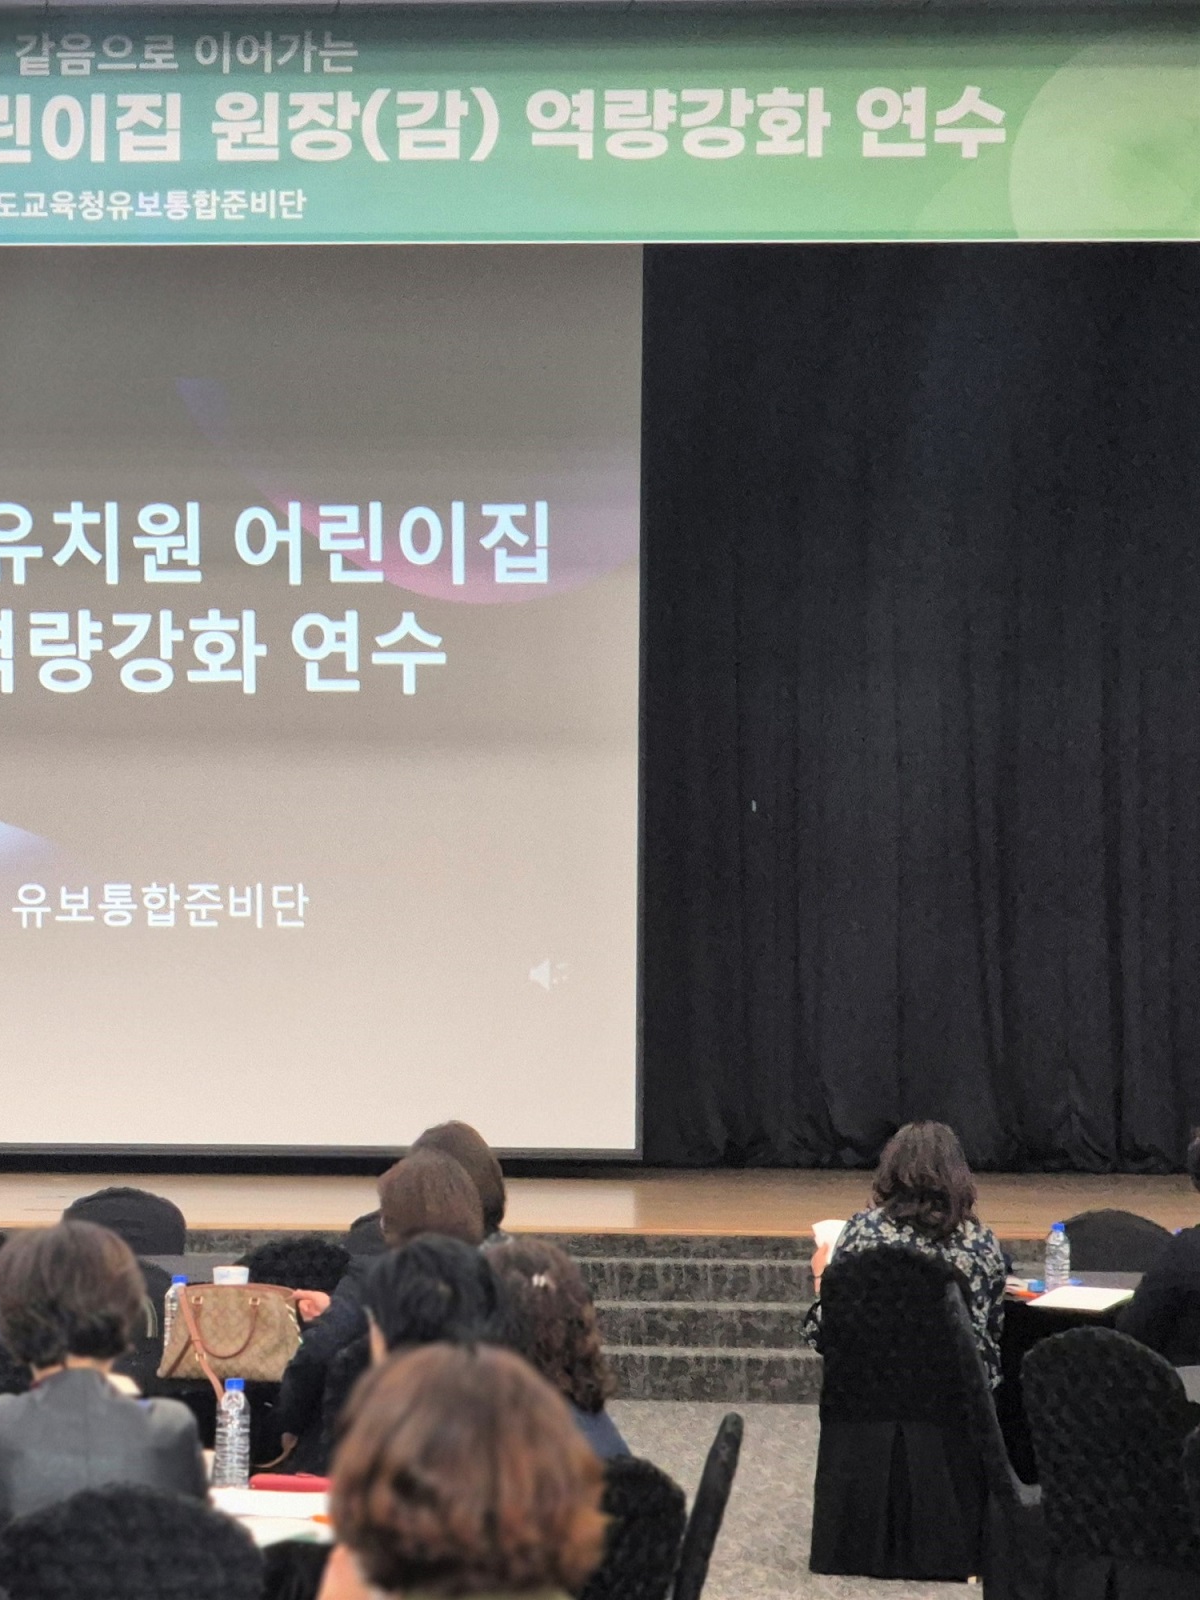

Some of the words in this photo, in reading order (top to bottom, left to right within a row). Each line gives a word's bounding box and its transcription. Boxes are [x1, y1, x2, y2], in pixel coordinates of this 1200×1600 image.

[15, 33, 179, 76] 같음으로
[194, 29, 359, 74] 이어가는
[211, 87, 500, 163] 원장(감)
[526, 87, 831, 161] 역량강화
[856, 86, 1007, 158] 연수
[234, 500, 549, 586] 어린이집
[291, 609, 447, 695] 연수
[10, 882, 310, 928] 유보통합준비단
